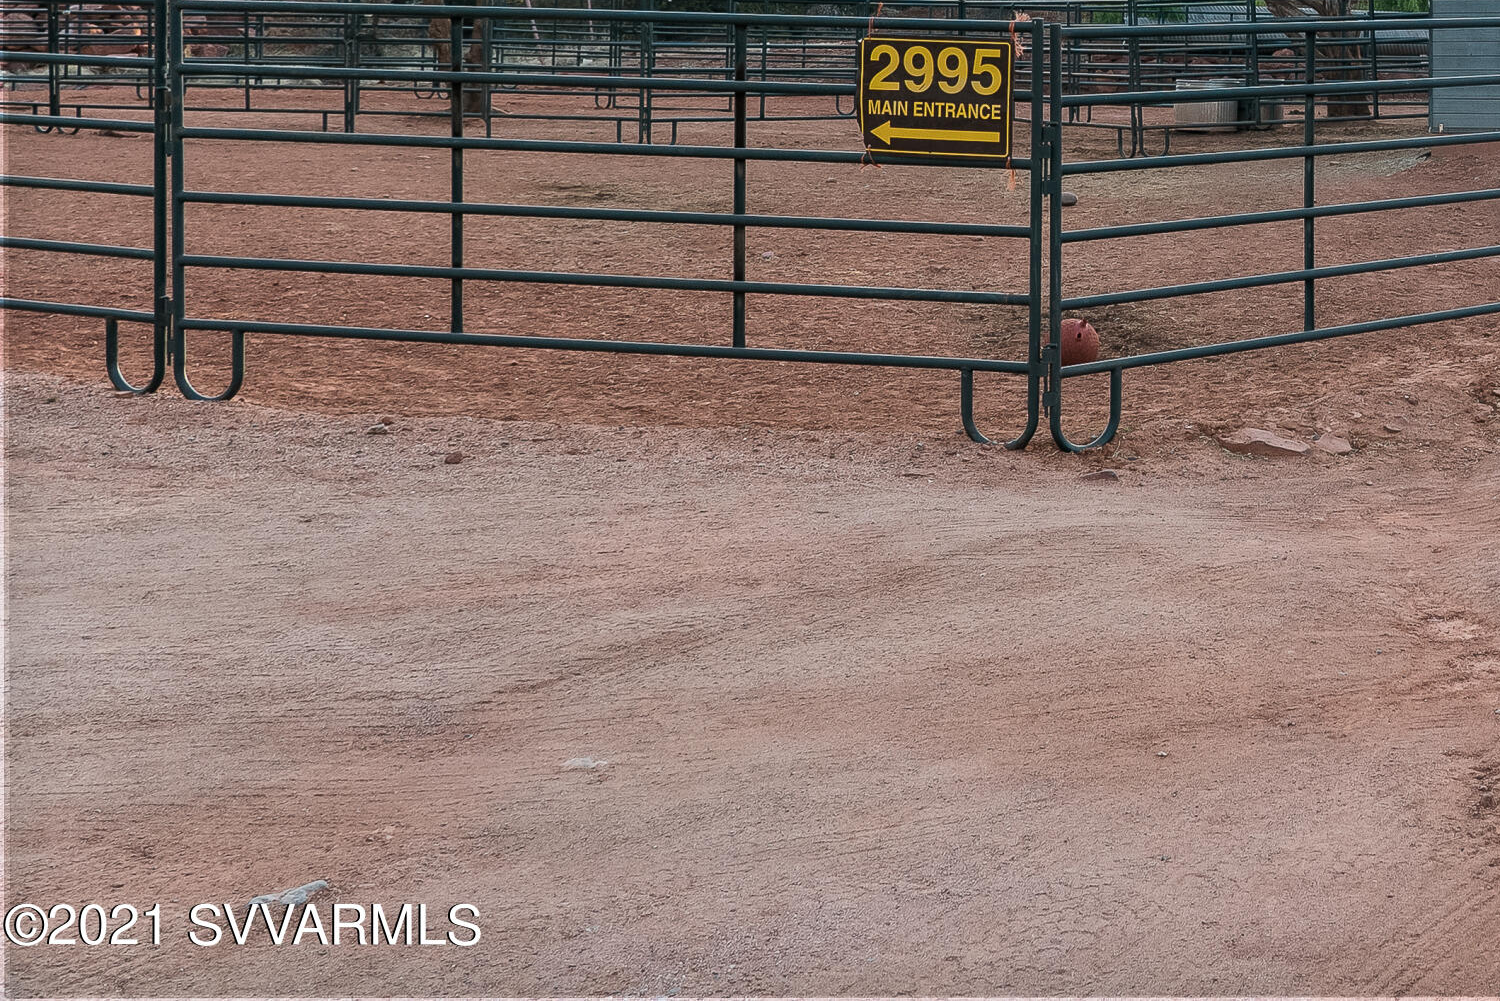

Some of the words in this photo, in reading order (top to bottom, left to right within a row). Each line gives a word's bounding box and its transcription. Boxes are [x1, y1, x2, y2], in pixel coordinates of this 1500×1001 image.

[868, 44, 1002, 96] 2995
[868, 99, 908, 117] MAIN
[913, 101, 1002, 120] ENTRANCE
